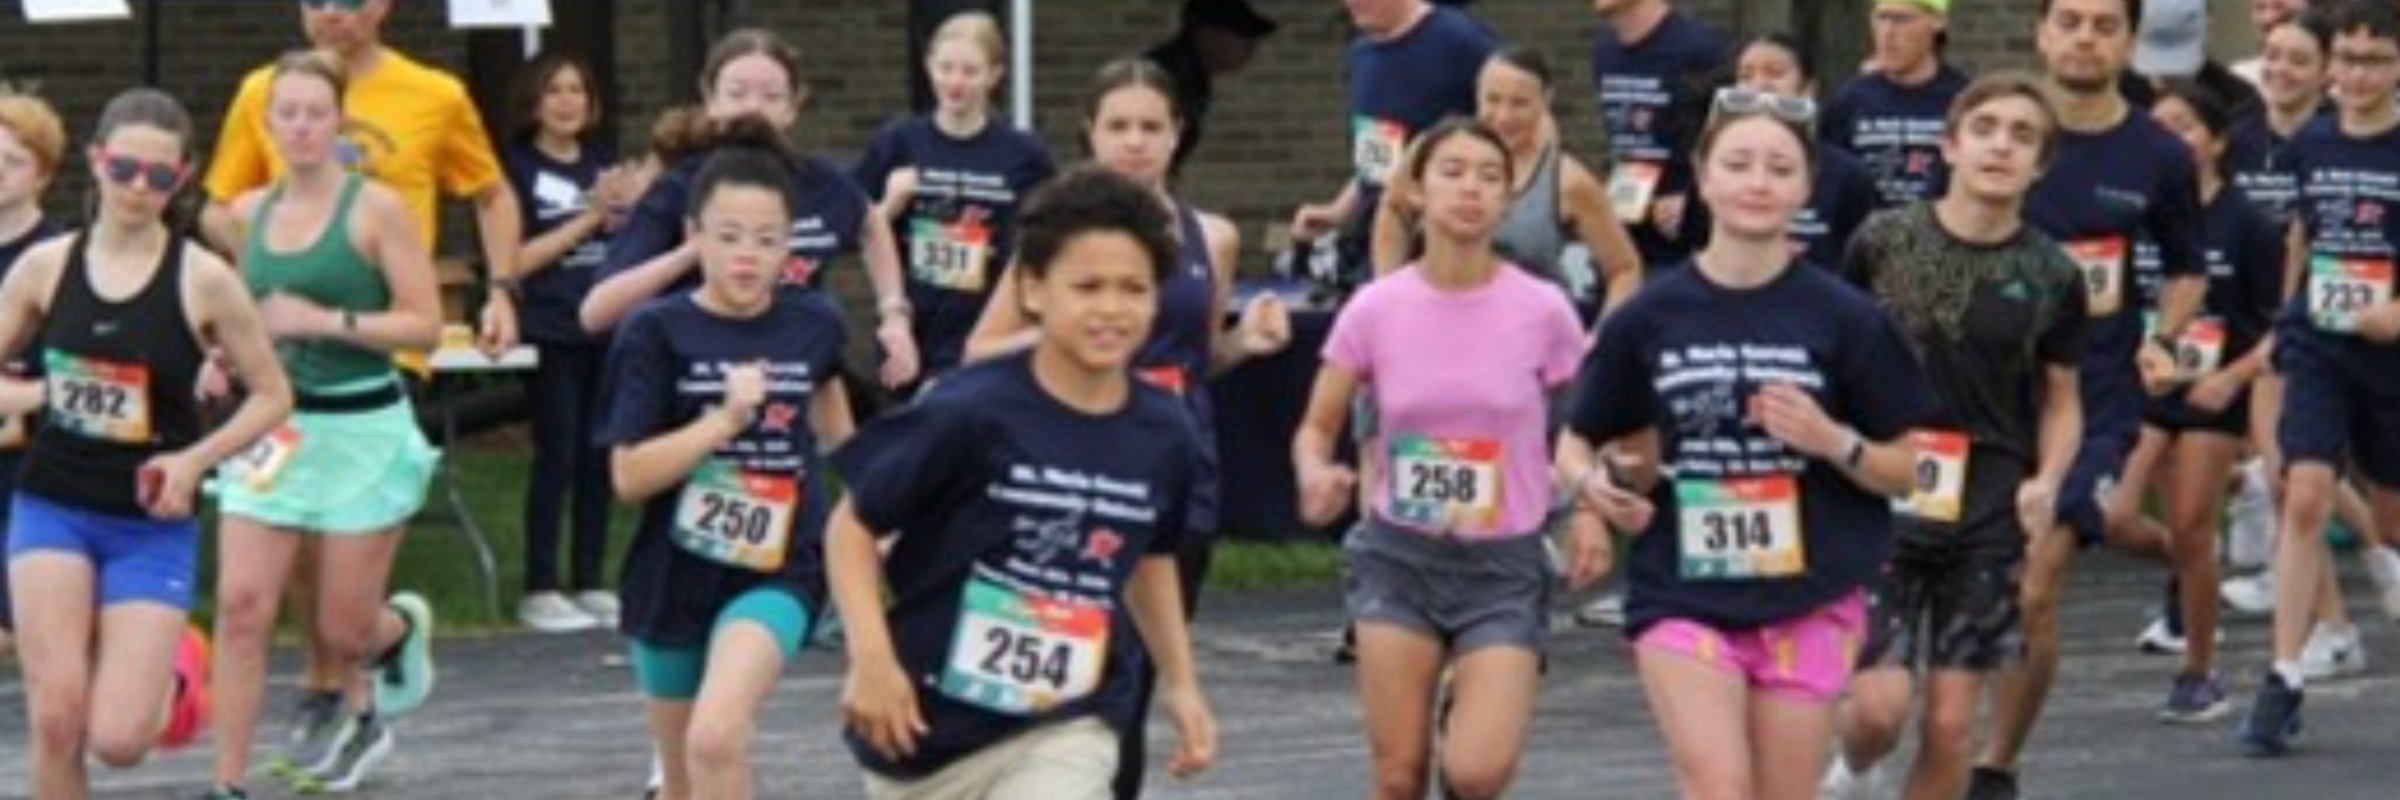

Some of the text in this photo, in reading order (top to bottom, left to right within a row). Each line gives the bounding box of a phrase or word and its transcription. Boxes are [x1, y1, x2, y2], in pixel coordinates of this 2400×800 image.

[61, 379, 127, 418] 282
[1411, 464, 1477, 504] 258
[696, 492, 771, 545] 250
[1703, 509, 1771, 550] 314
[980, 625, 1074, 691] 254
